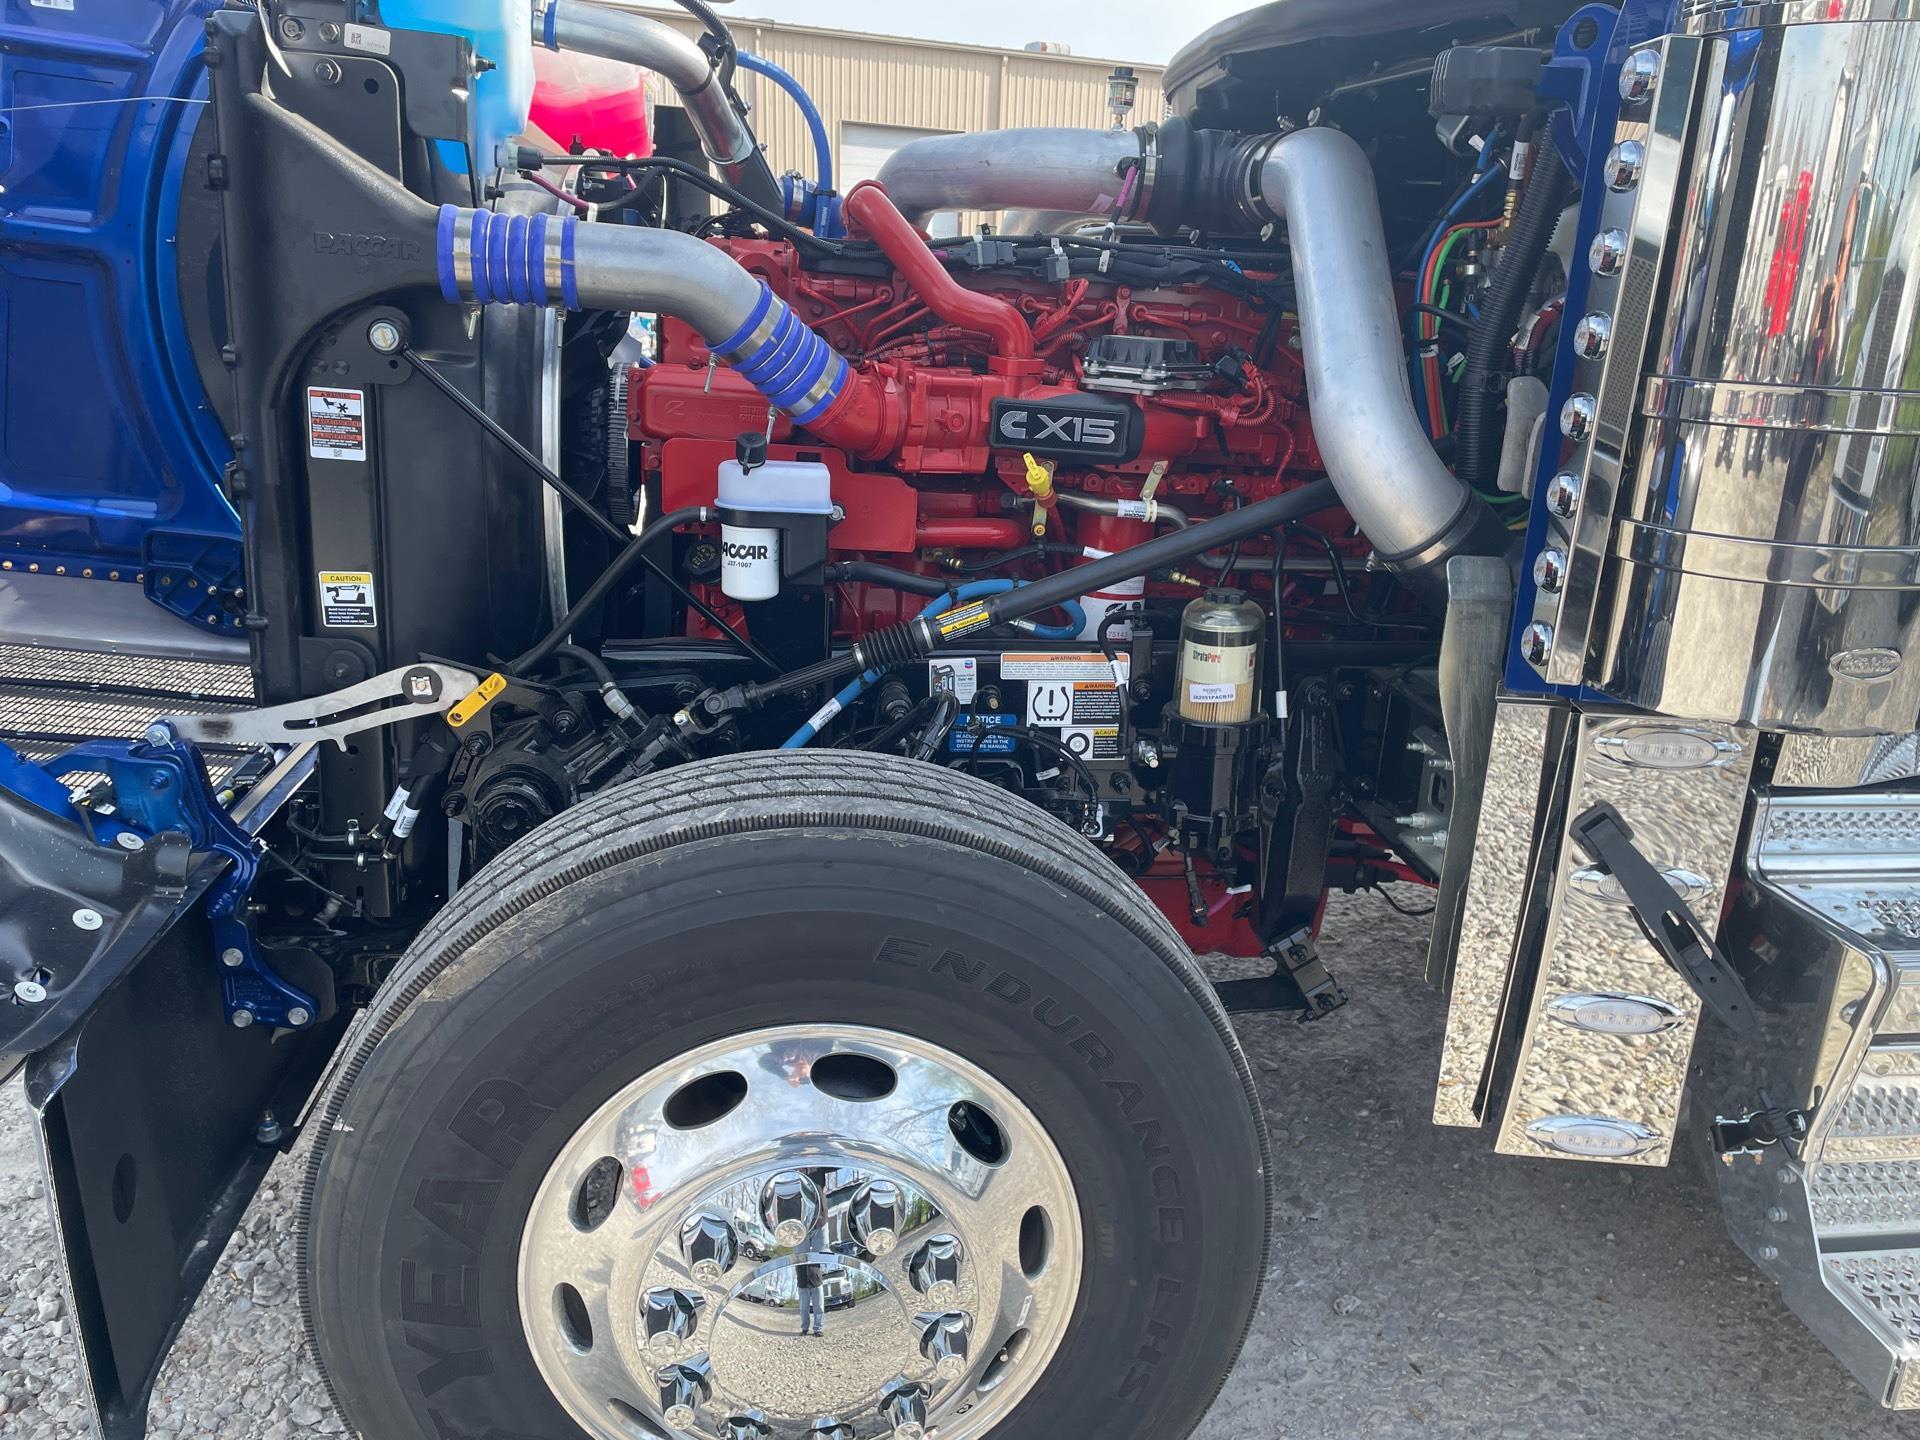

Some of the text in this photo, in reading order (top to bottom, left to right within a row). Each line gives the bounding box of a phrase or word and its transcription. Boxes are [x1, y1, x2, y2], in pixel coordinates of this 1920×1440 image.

[1033, 414, 1116, 445] X15
[721, 541, 768, 560] ACCAR
[873, 934, 1186, 1244] ENDURANCE
